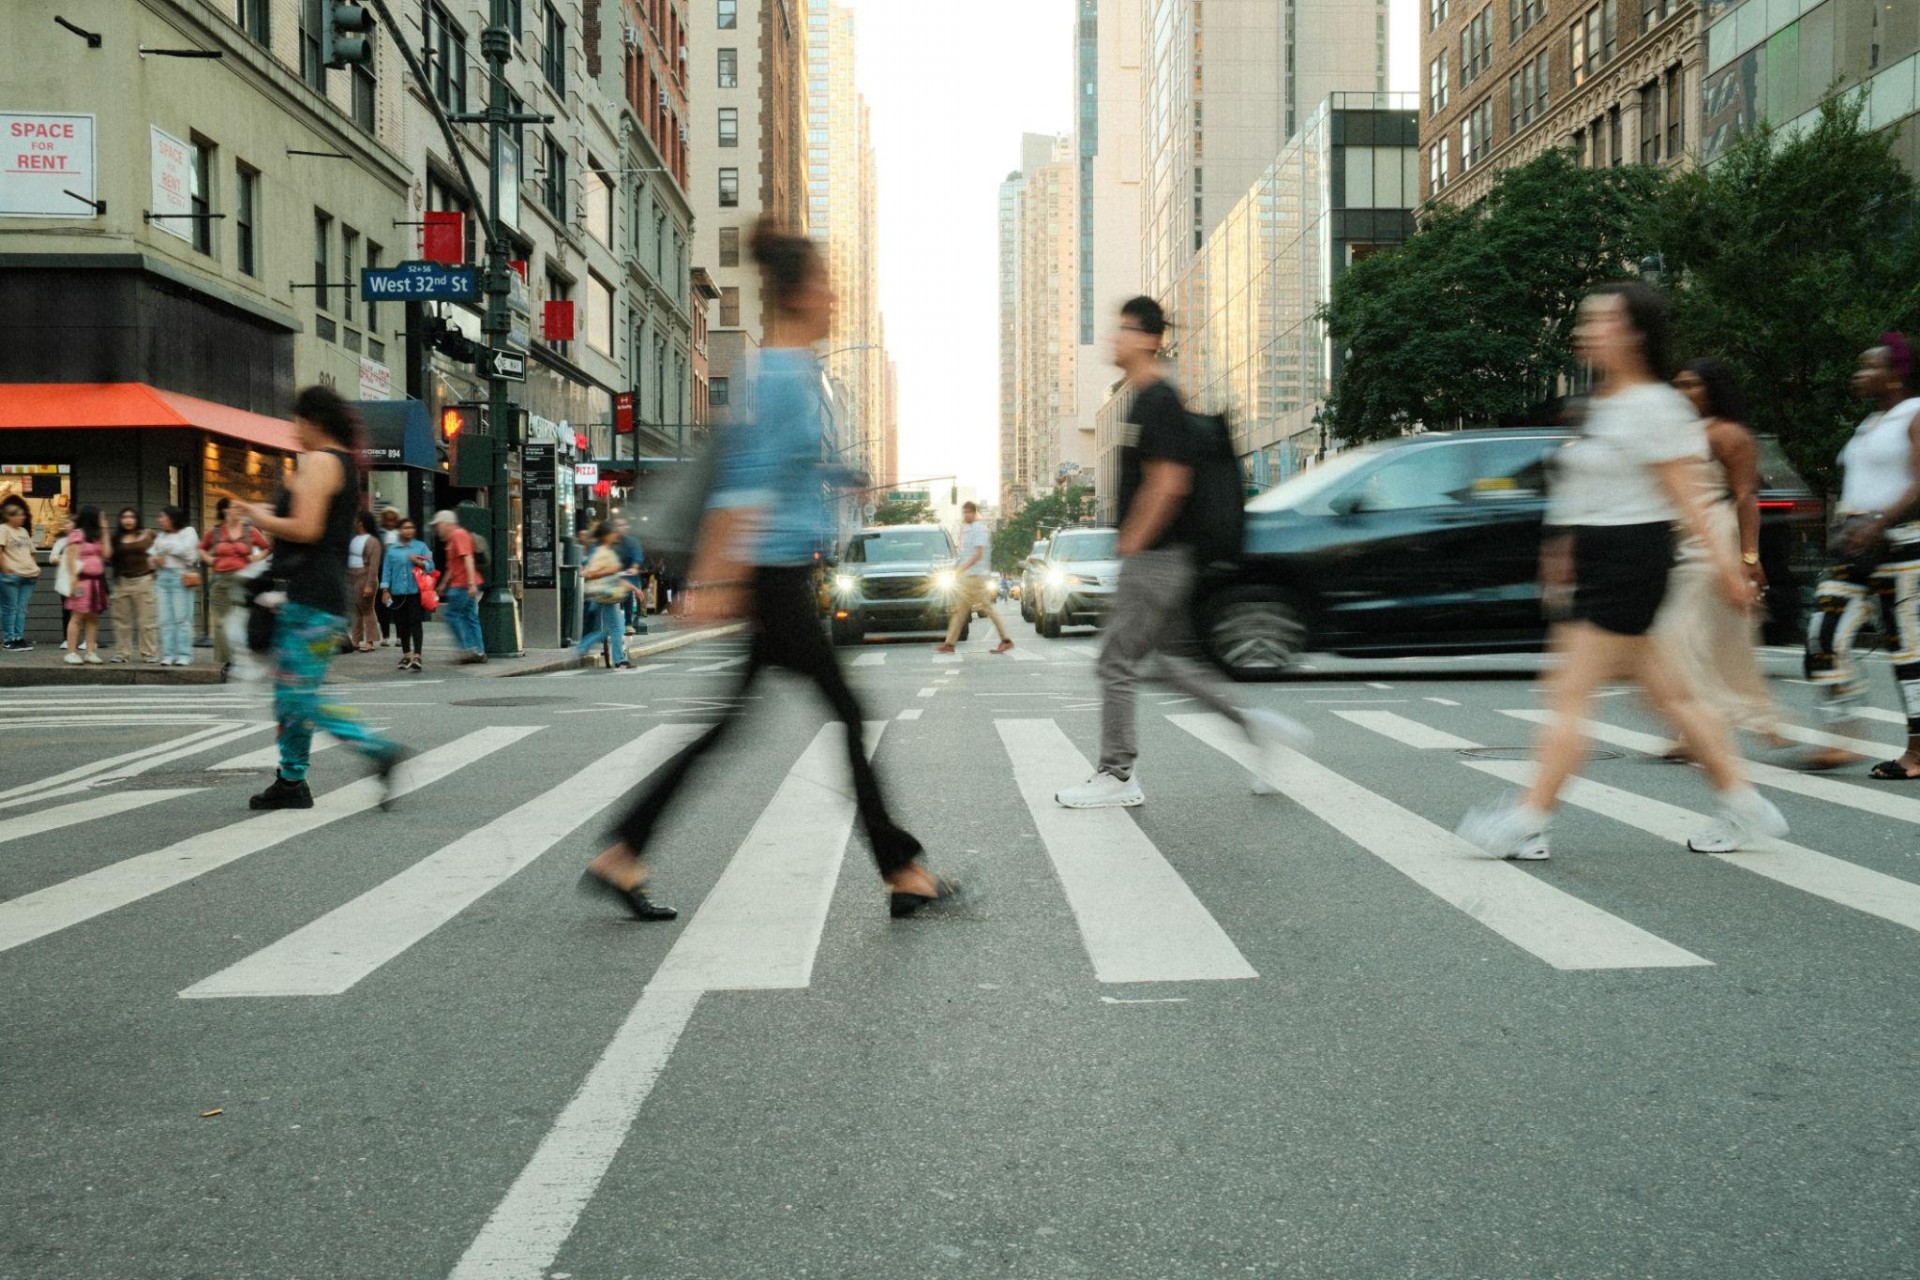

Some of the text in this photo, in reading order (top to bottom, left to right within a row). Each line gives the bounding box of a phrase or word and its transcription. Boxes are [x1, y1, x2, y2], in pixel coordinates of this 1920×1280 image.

[11, 122, 74, 139] SPACE
[31, 141, 54, 151] FOR
[17, 154, 68, 170] RENT
[370, 275, 468, 293] West 32nd St
[388, 449, 400, 458] 894
[576, 466, 596, 476] PIZZA
